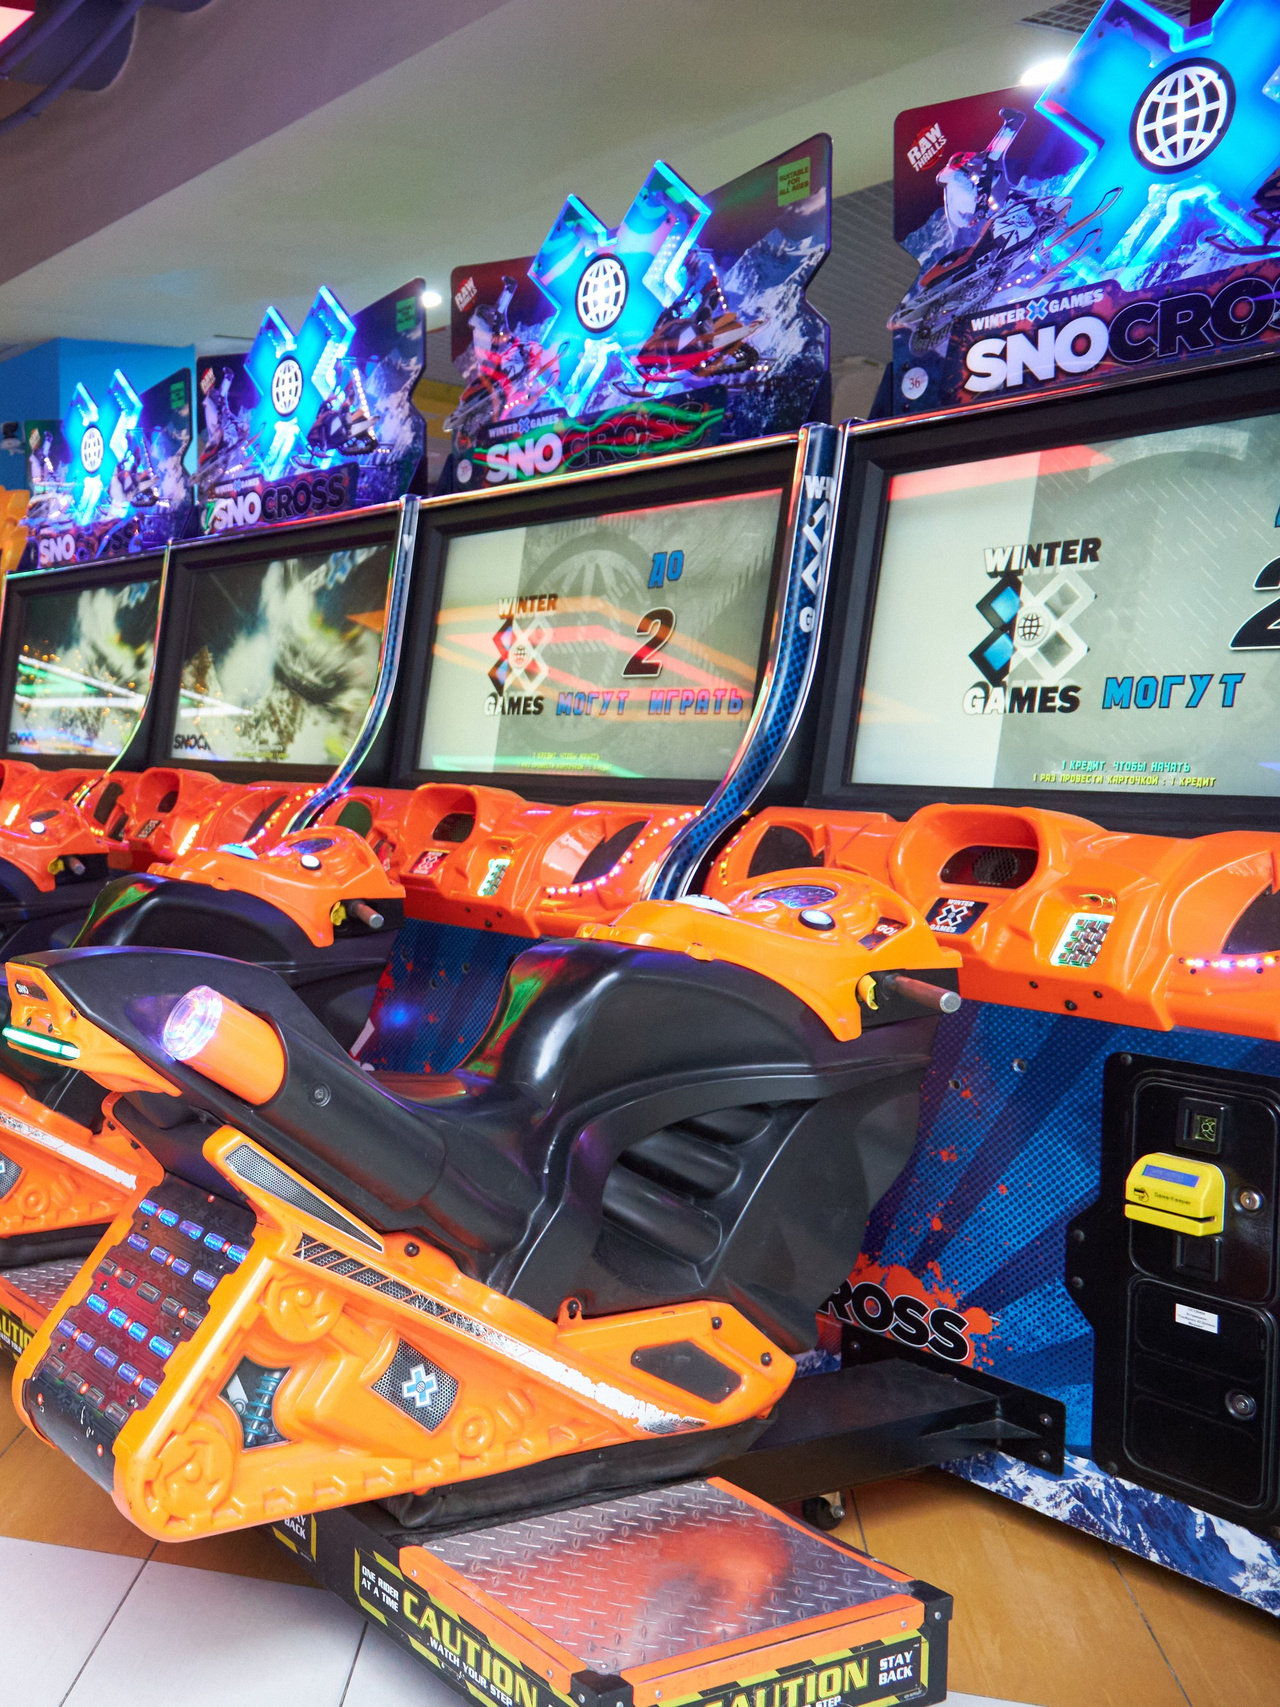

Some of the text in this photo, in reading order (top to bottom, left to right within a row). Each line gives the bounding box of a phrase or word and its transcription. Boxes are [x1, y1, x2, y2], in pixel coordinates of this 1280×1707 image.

[907, 122, 942, 165] RAW
[913, 135, 947, 172] THRILLS
[971, 309, 1025, 331] WINTER
[1049, 288, 1104, 313] GAMES
[489, 424, 518, 438] WINTER
[530, 413, 559, 429] GAMES
[648, 550, 684, 588] ДО
[984, 537, 1101, 577] WINTER
[498, 594, 558, 619] WINTER
[622, 606, 677, 678] 2
[483, 695, 544, 716] GAMES
[556, 688, 743, 716] МОГУТ ИГРАТЬ
[963, 685, 1081, 715] GAMES
[1102, 673, 1246, 710] МОГУТ
[1113, 761, 1147, 772] ЧТОБЫ
[1151, 762, 1191, 773] НАЧАТЬ
[1180, 777, 1216, 788] КРЕДИТ
[948, 899, 975, 907] WINTER
[876, 924, 897, 936] GO!
[930, 924, 957, 933] GAMES
[284, 1518, 306, 1540] BACK
[361, 1578, 399, 1613] AT A TIME
[362, 1565, 399, 1601] ONE RIDER
[403, 1589, 538, 1707] CAUTION
[879, 1651, 913, 1671] STAY
[429, 1636, 513, 1707] WATCH YOUR STEP
[878, 1666, 913, 1686] BACK
